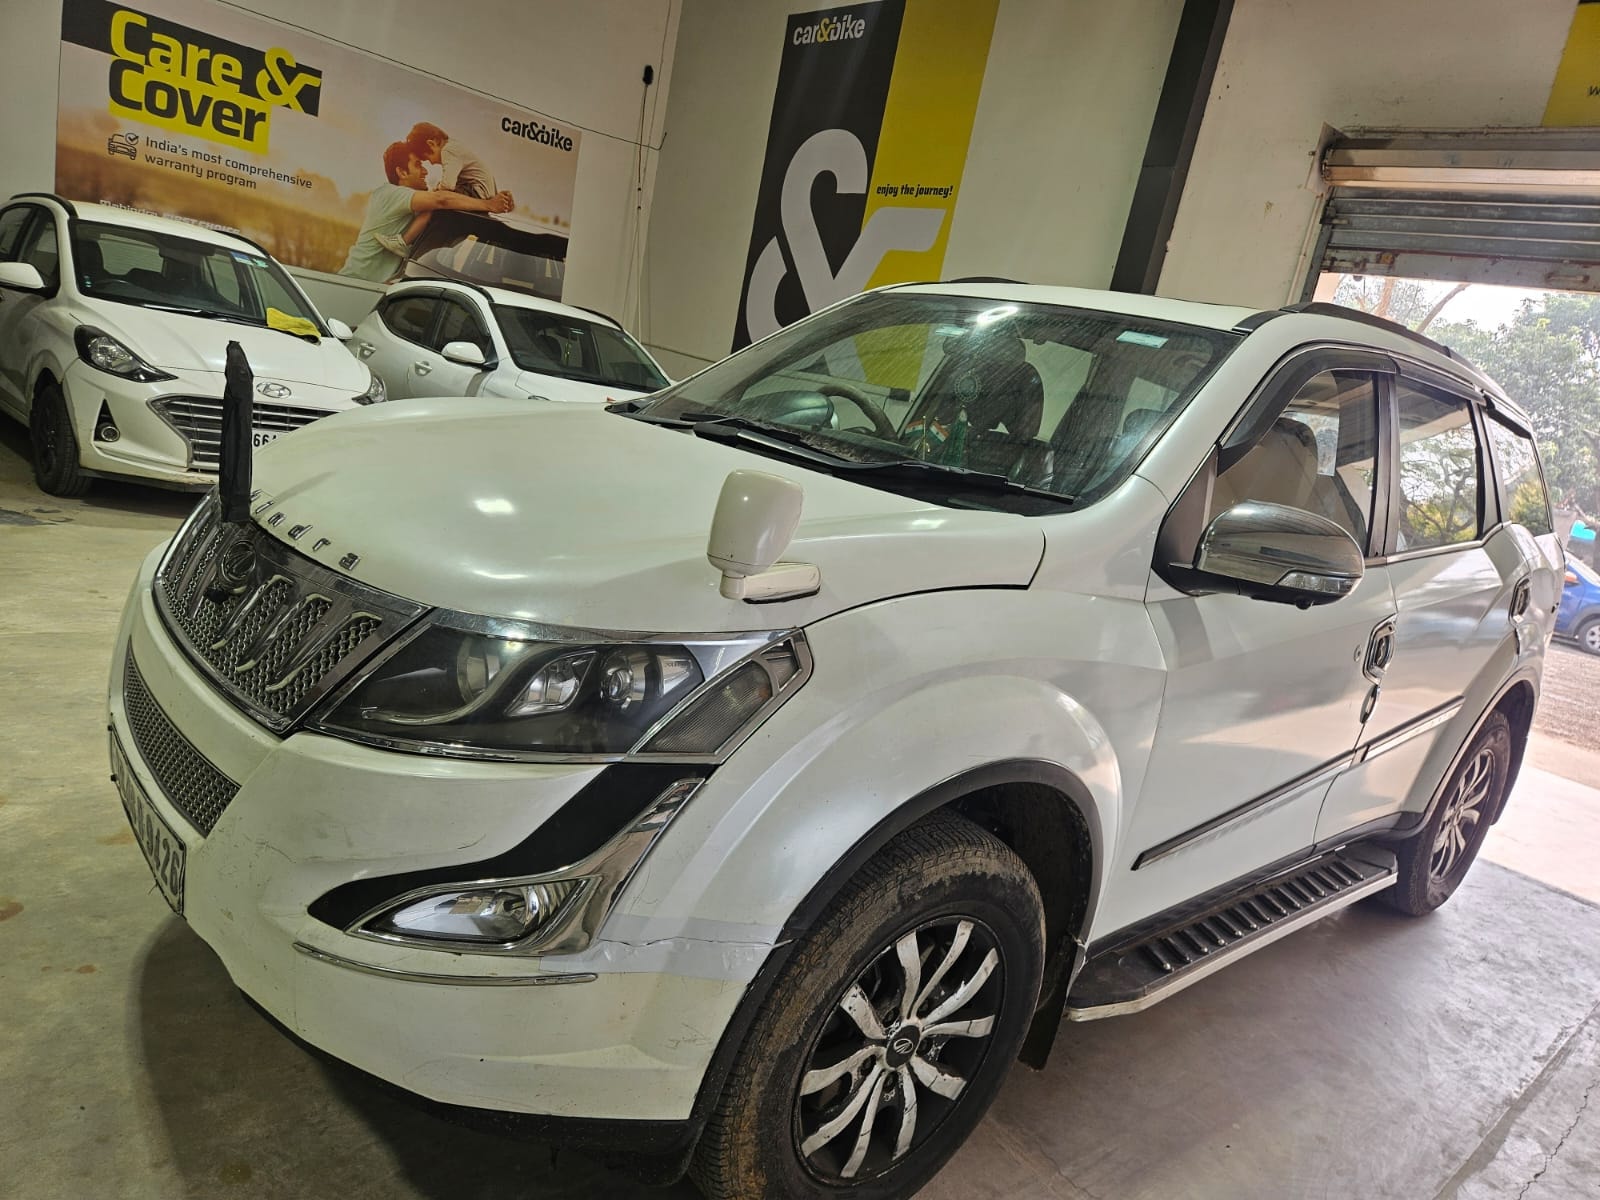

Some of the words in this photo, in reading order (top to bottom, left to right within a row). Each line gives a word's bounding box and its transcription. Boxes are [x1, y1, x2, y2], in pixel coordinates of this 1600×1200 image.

[793, 14, 866, 46] car&bike
[110, 10, 243, 93] Care
[256, 47, 321, 112] &
[109, 59, 266, 142] Cover
[501, 117, 573, 152] car&bike
[144, 153, 203, 178] warranty
[207, 169, 257, 189] program
[146, 136, 188, 155] India's
[192, 150, 222, 165] most
[225, 158, 313, 188] comprehensive
[876, 184, 899, 197] enjoy
[901, 184, 915, 195] the
[915, 184, 954, 198] journey!
